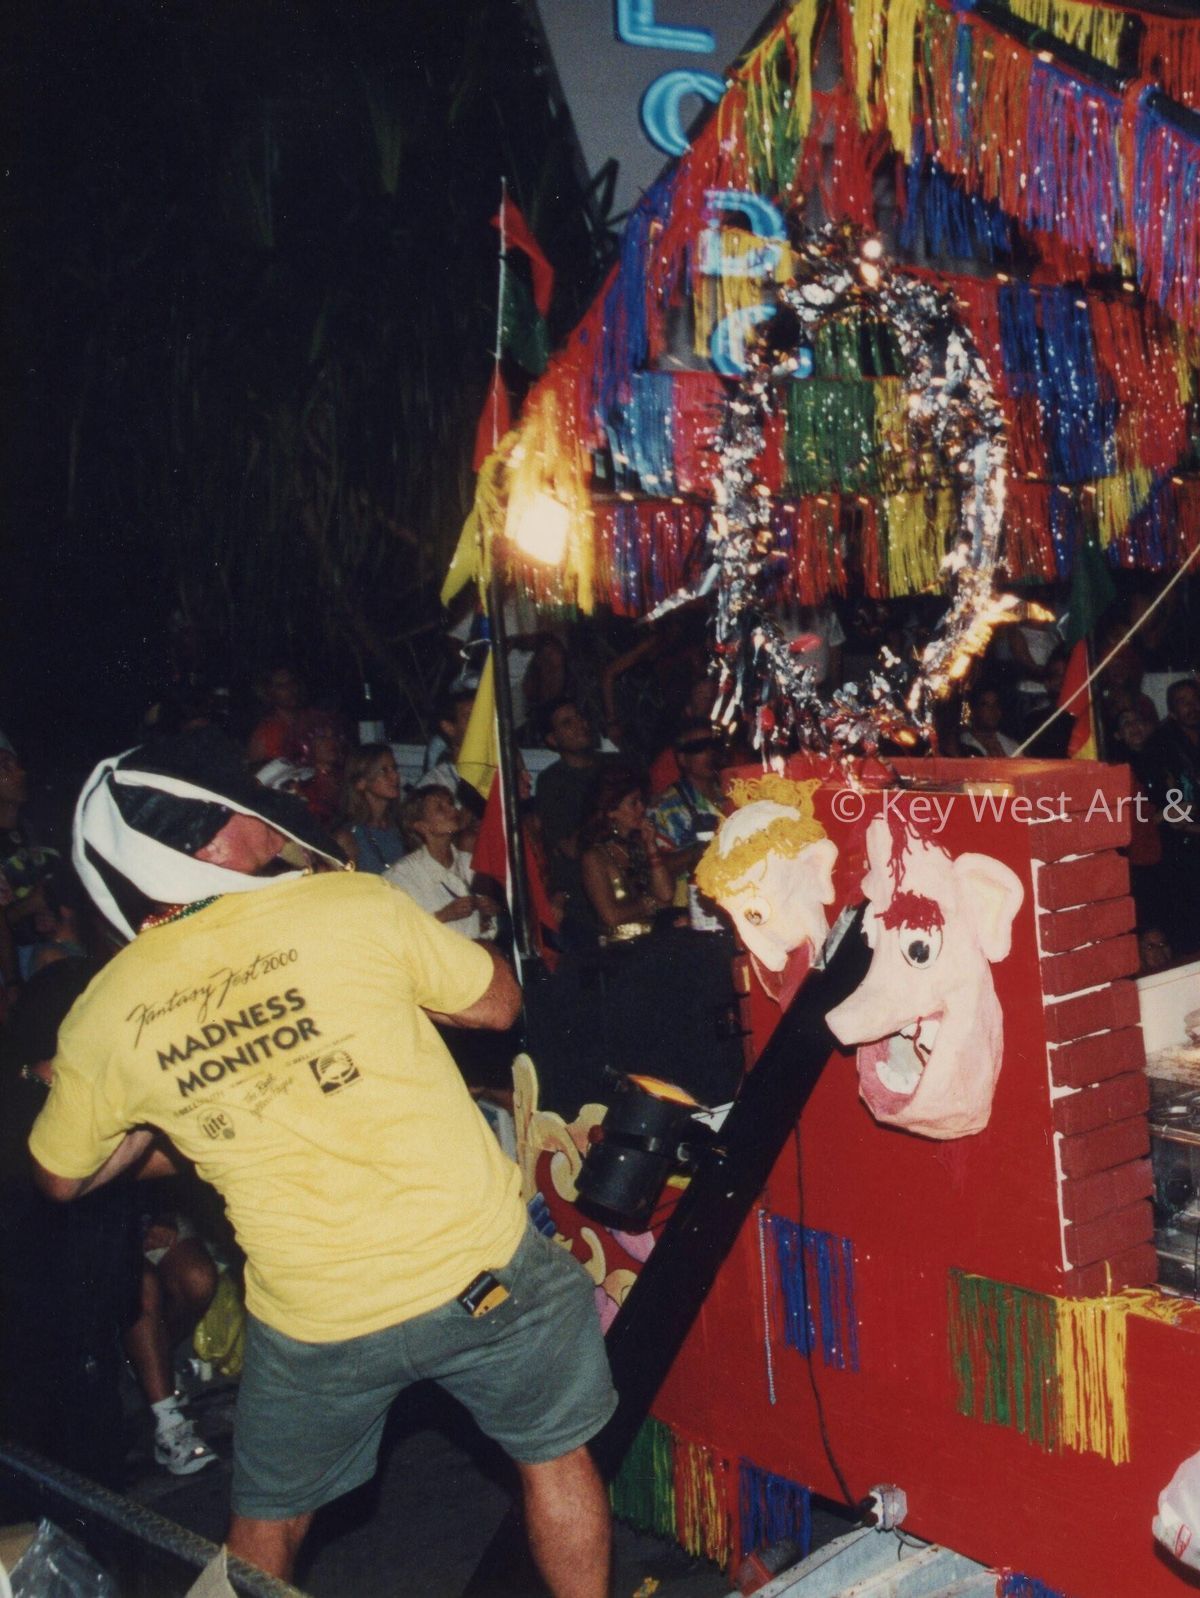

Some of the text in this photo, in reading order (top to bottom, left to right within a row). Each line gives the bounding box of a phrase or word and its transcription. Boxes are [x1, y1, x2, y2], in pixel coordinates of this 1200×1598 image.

[125, 982, 216, 1050] Fantasy
[208, 950, 276, 1009] Fest
[262, 948, 298, 975] 2000
[156, 987, 307, 1071] MADNESS
[177, 1017, 321, 1097] MONITOR
[202, 1112, 228, 1140] Lite
